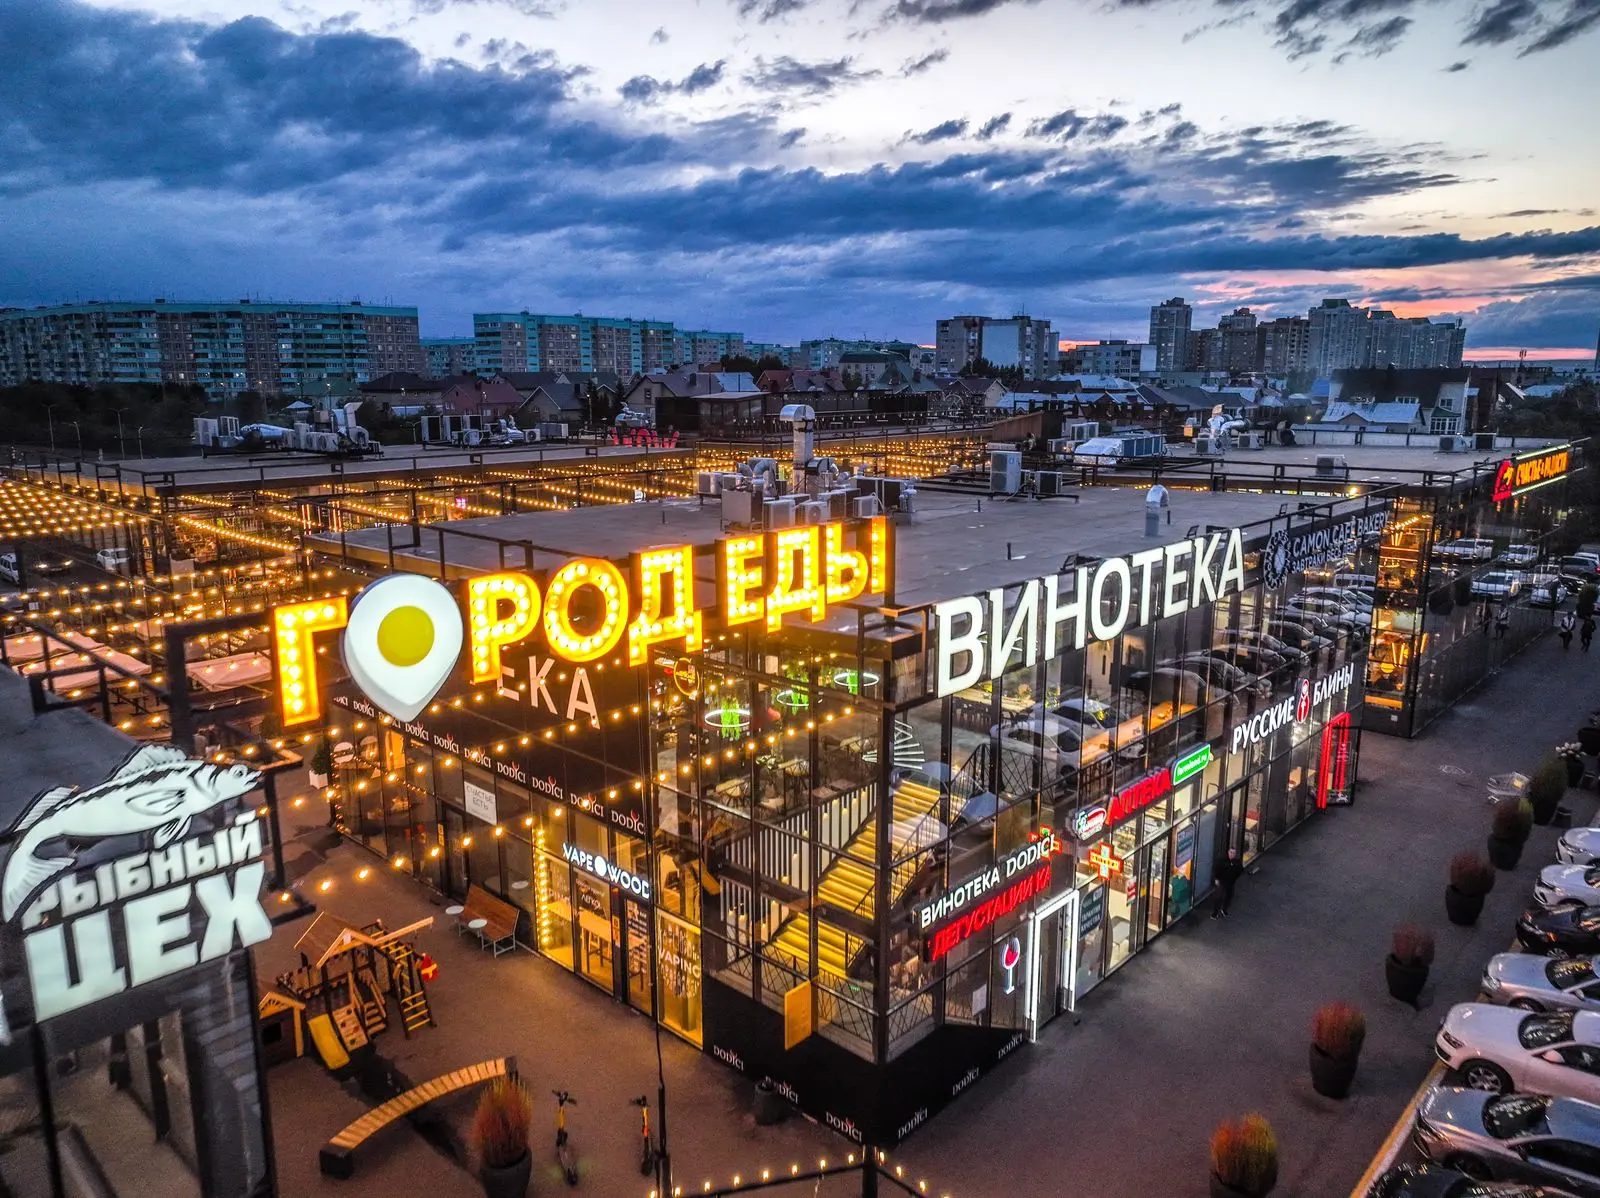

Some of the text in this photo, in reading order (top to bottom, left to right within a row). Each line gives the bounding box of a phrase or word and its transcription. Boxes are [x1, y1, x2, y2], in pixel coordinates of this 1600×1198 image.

[725, 514, 888, 634] ЕДЫ
[1292, 528, 1330, 558] CAMON
[1357, 510, 1390, 536] BAKERY
[935, 527, 1245, 699] ВИНОТЕКА
[494, 655, 601, 730] ЕКА
[1232, 662, 1354, 755] РУССКИЕ БЛИНЫ
[405, 721, 429, 741] DODICI
[434, 732, 460, 754] DODICI
[496, 761, 527, 784] DODICI
[531, 775, 563, 800] DODICI
[610, 807, 648, 836] DODIC
[1105, 767, 1173, 826] АПТЕКА
[20, 808, 265, 933] РЫБНЫЙ
[562, 842, 594, 872] VAPE
[607, 863, 650, 899] WOOD
[920, 833, 1056, 929] ВИНОТЕКА DODICI
[932, 873, 1034, 962] ДЕГУСТАЦИИ
[23, 860, 274, 1025] ЦЕХ
[713, 1043, 744, 1071] DODICI
[826, 1110, 862, 1143] DODICI
